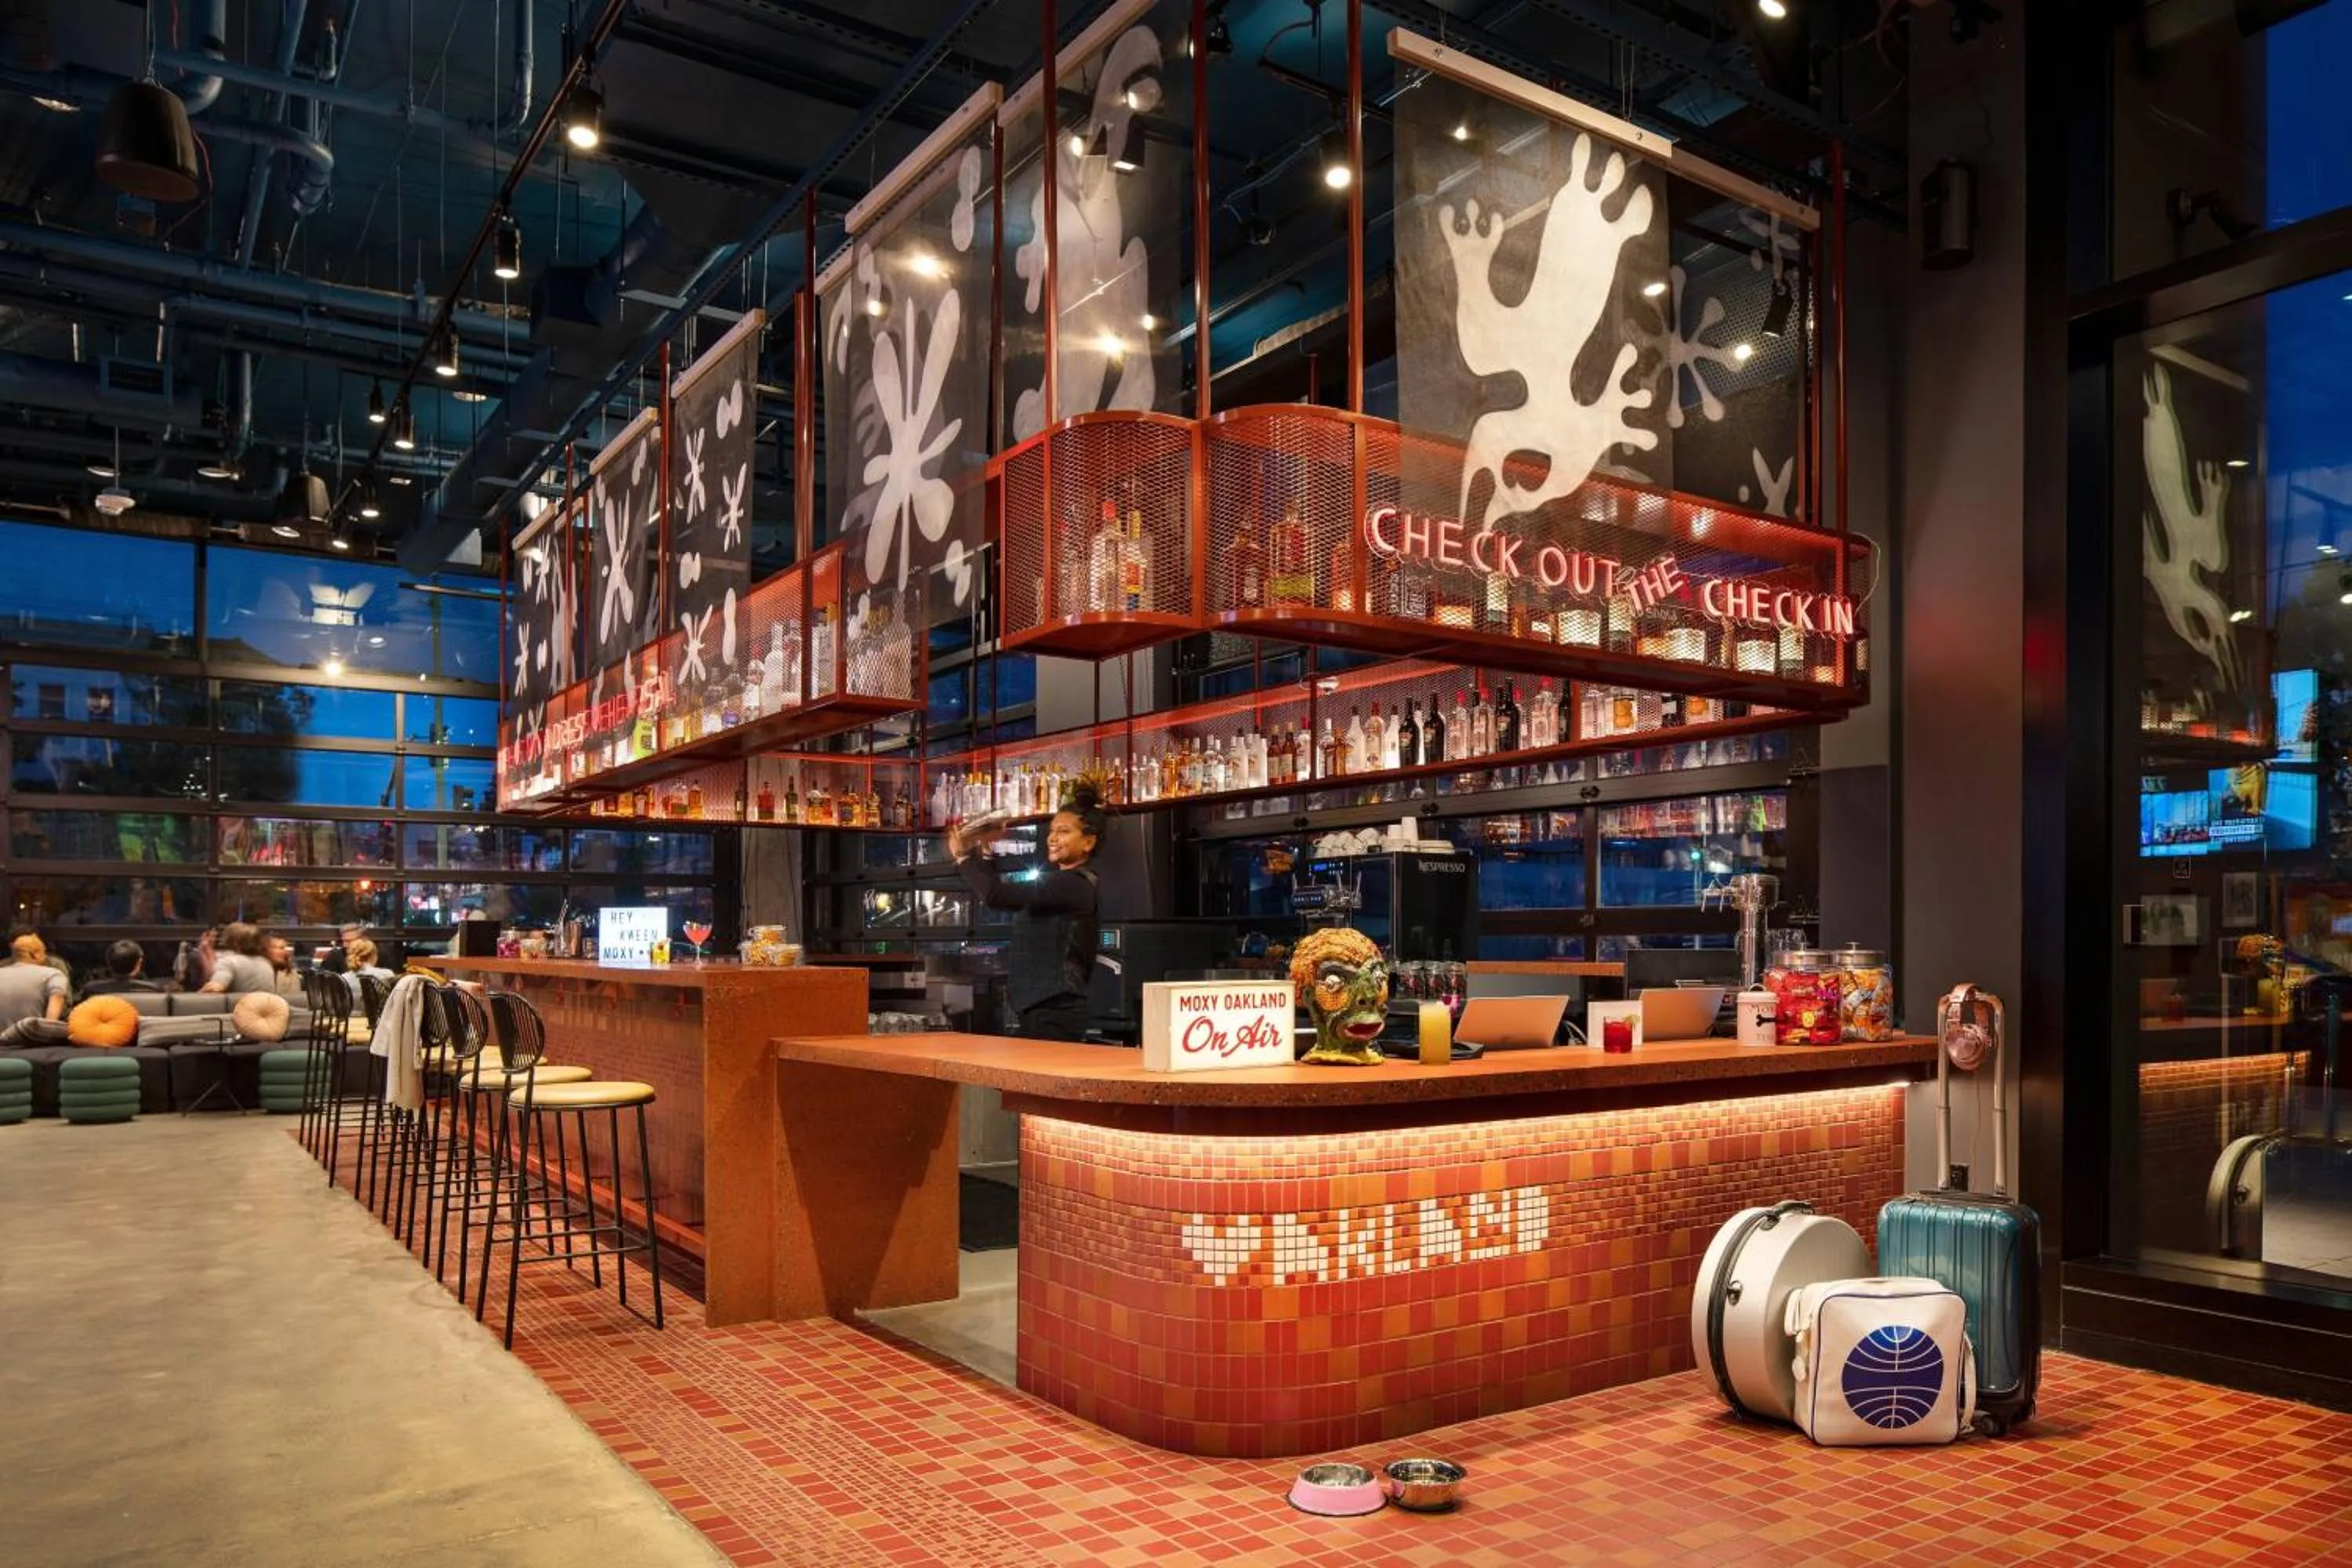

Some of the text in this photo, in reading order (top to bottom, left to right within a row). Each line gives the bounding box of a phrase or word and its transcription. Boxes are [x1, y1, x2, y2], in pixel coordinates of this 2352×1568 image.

[1370, 507, 1853, 634] CHECK OUT THE CHECK IN
[1417, 860, 1465, 873] NESPRESSO
[611, 912, 633, 924] HEY
[619, 929, 658, 941] KWEEN
[603, 947, 633, 959] MOXY
[1180, 993, 1287, 1012] MOXY OAKLAND
[1182, 1014, 1282, 1058] On Air
